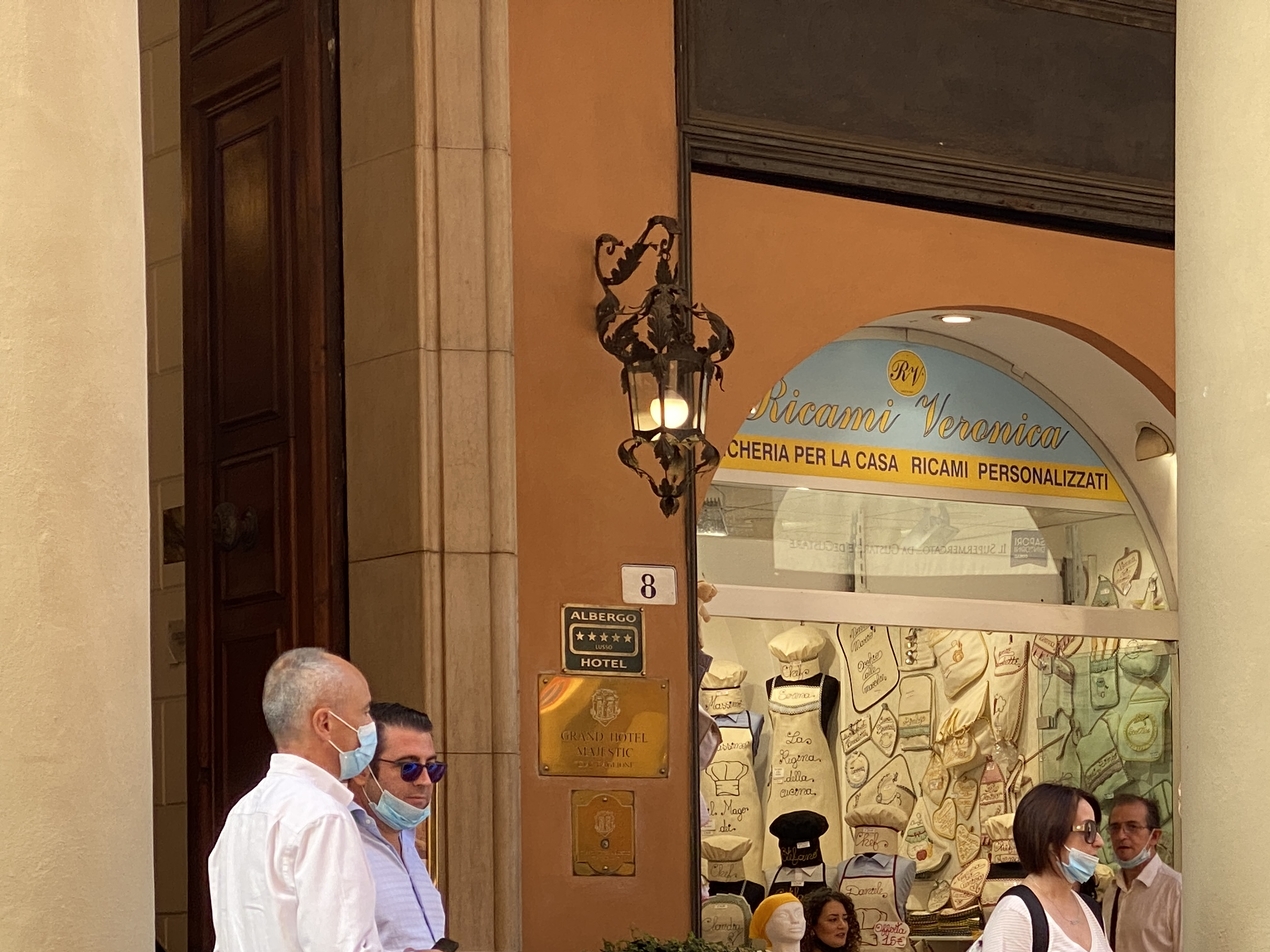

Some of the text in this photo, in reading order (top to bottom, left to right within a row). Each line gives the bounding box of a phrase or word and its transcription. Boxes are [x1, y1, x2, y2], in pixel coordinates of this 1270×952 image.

[746, 376, 1070, 450] Ricami Veronica
[723, 439, 1109, 491] CHERIA PER LA CASA RICAMI PERSONALIZZATI
[640, 573, 657, 599] 8
[570, 611, 637, 623] ALBERGO
[580, 657, 628, 669] HOTEL
[560, 730, 649, 744] GRAND HOTEL
[784, 731, 812, 746] La
[577, 746, 634, 758] MAJESTIC
[855, 832, 889, 852] Chef
[881, 934, 906, 947] 15€
